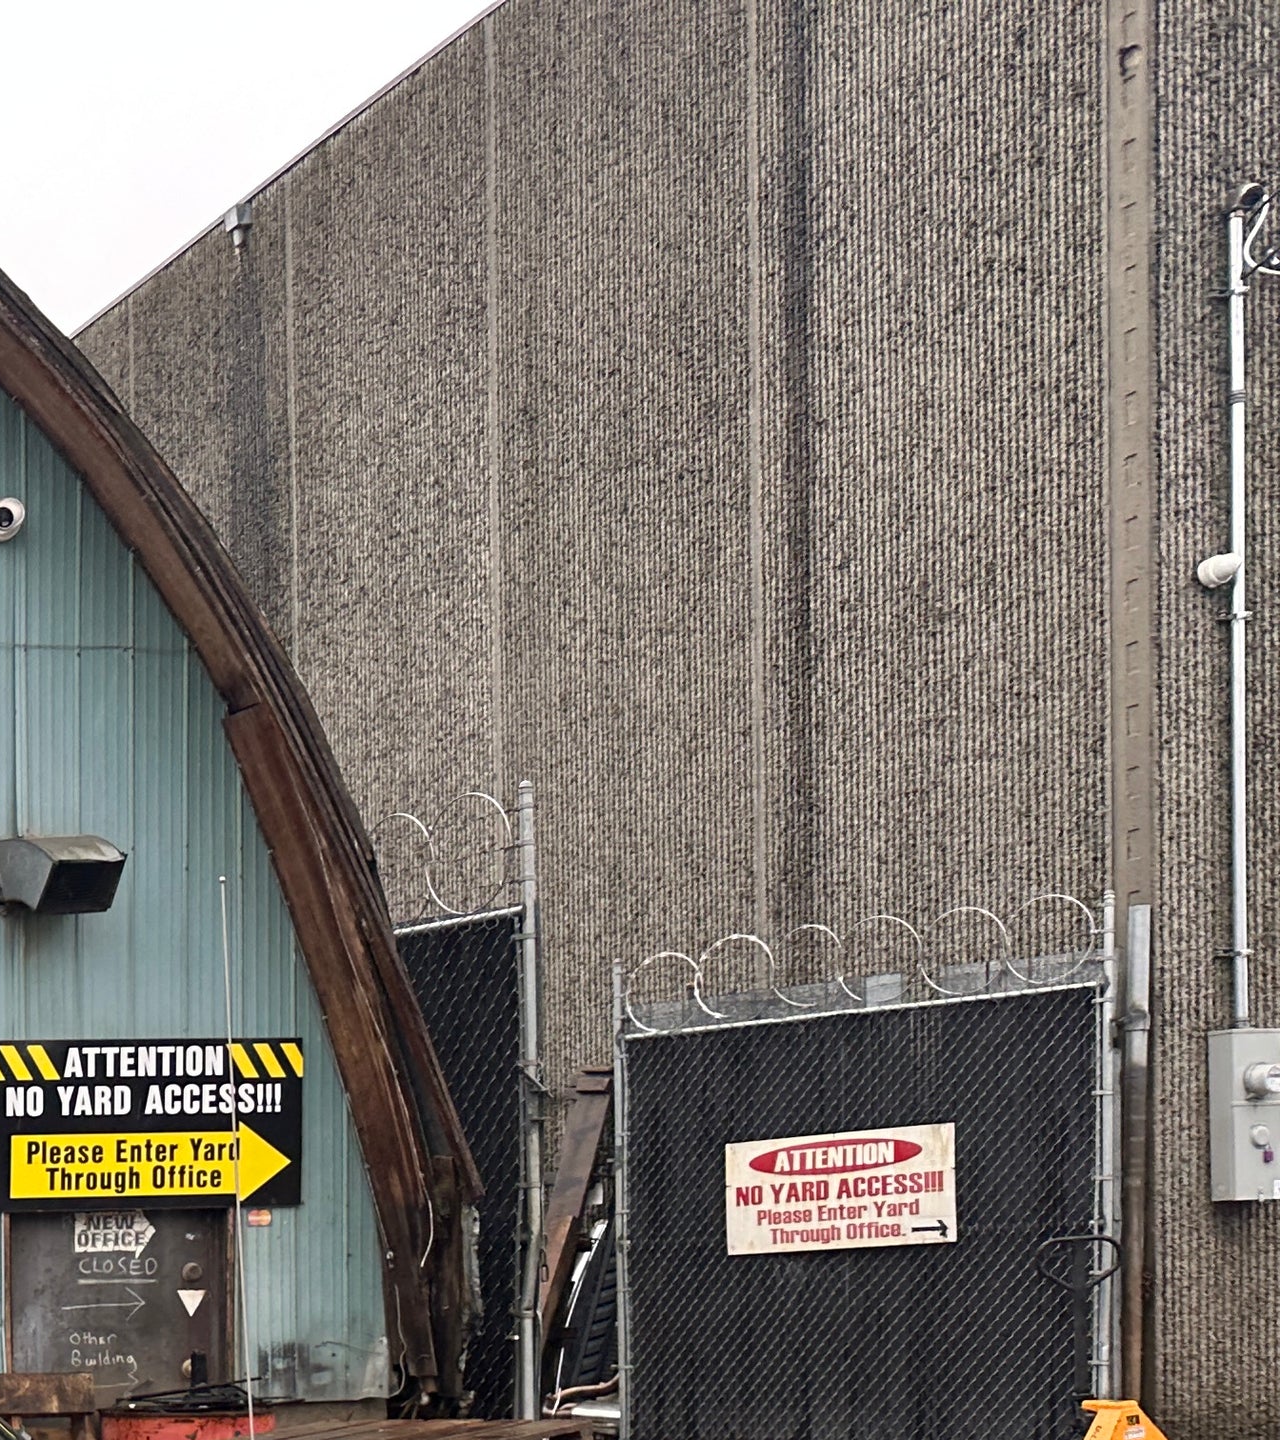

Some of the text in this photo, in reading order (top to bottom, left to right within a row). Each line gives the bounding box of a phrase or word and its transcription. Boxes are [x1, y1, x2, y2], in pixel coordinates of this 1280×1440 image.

[62, 1044, 225, 1079] ATTENTION
[5, 1082, 283, 1118] NO YARD ACCESS!!!
[26, 1137, 240, 1165] Please Enter Yard
[774, 1140, 896, 1173] ATTENTION
[45, 1164, 222, 1194] Through Office
[735, 1170, 944, 1207] NO YARD ACCESS!!!
[87, 1213, 134, 1230] NEW
[757, 1198, 920, 1226] Please Enter Yard
[77, 1230, 146, 1248] OFFICE
[770, 1222, 907, 1245] Through Office.
[79, 1256, 158, 1276] CLOSED
[69, 1331, 118, 1345] Other
